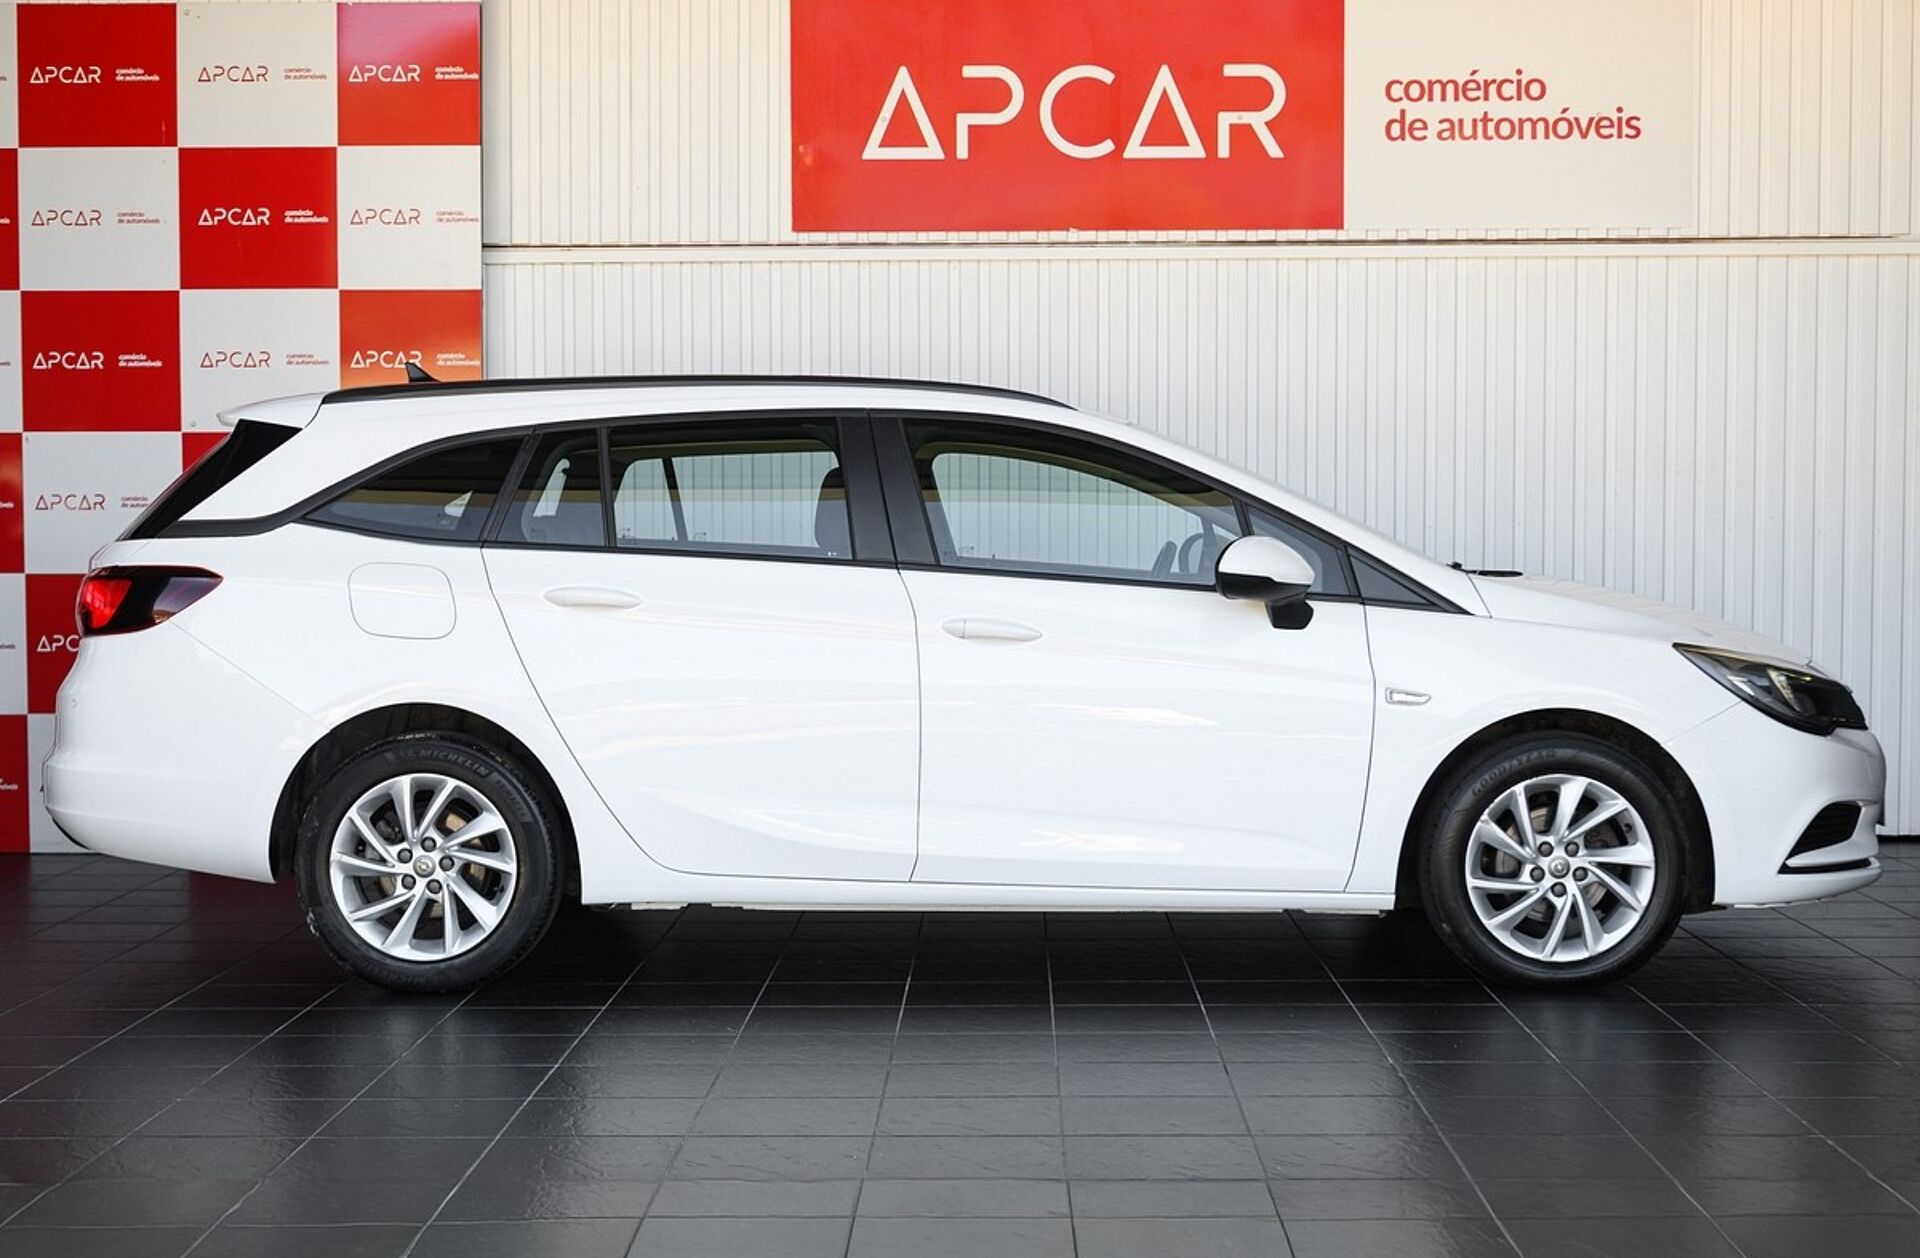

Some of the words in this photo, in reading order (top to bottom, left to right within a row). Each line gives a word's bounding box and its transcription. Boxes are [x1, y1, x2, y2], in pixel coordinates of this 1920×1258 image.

[30, 66, 101, 84] APCAR
[198, 65, 269, 82] APCAR
[348, 64, 421, 82] APCAR
[1384, 68, 1547, 102] comércio
[861, 64, 1287, 160] APCAR
[1384, 108, 1428, 141] de
[1436, 106, 1642, 141] automóveis
[31, 210, 102, 226] APCAR
[198, 208, 270, 226] APCAR
[350, 208, 421, 225] APCAR
[32, 352, 104, 369] APCAR
[200, 351, 271, 368] APCAR
[35, 494, 106, 510] APCAR
[36, 634, 80, 652] APC
[418, 748, 490, 776] MICHELIN
